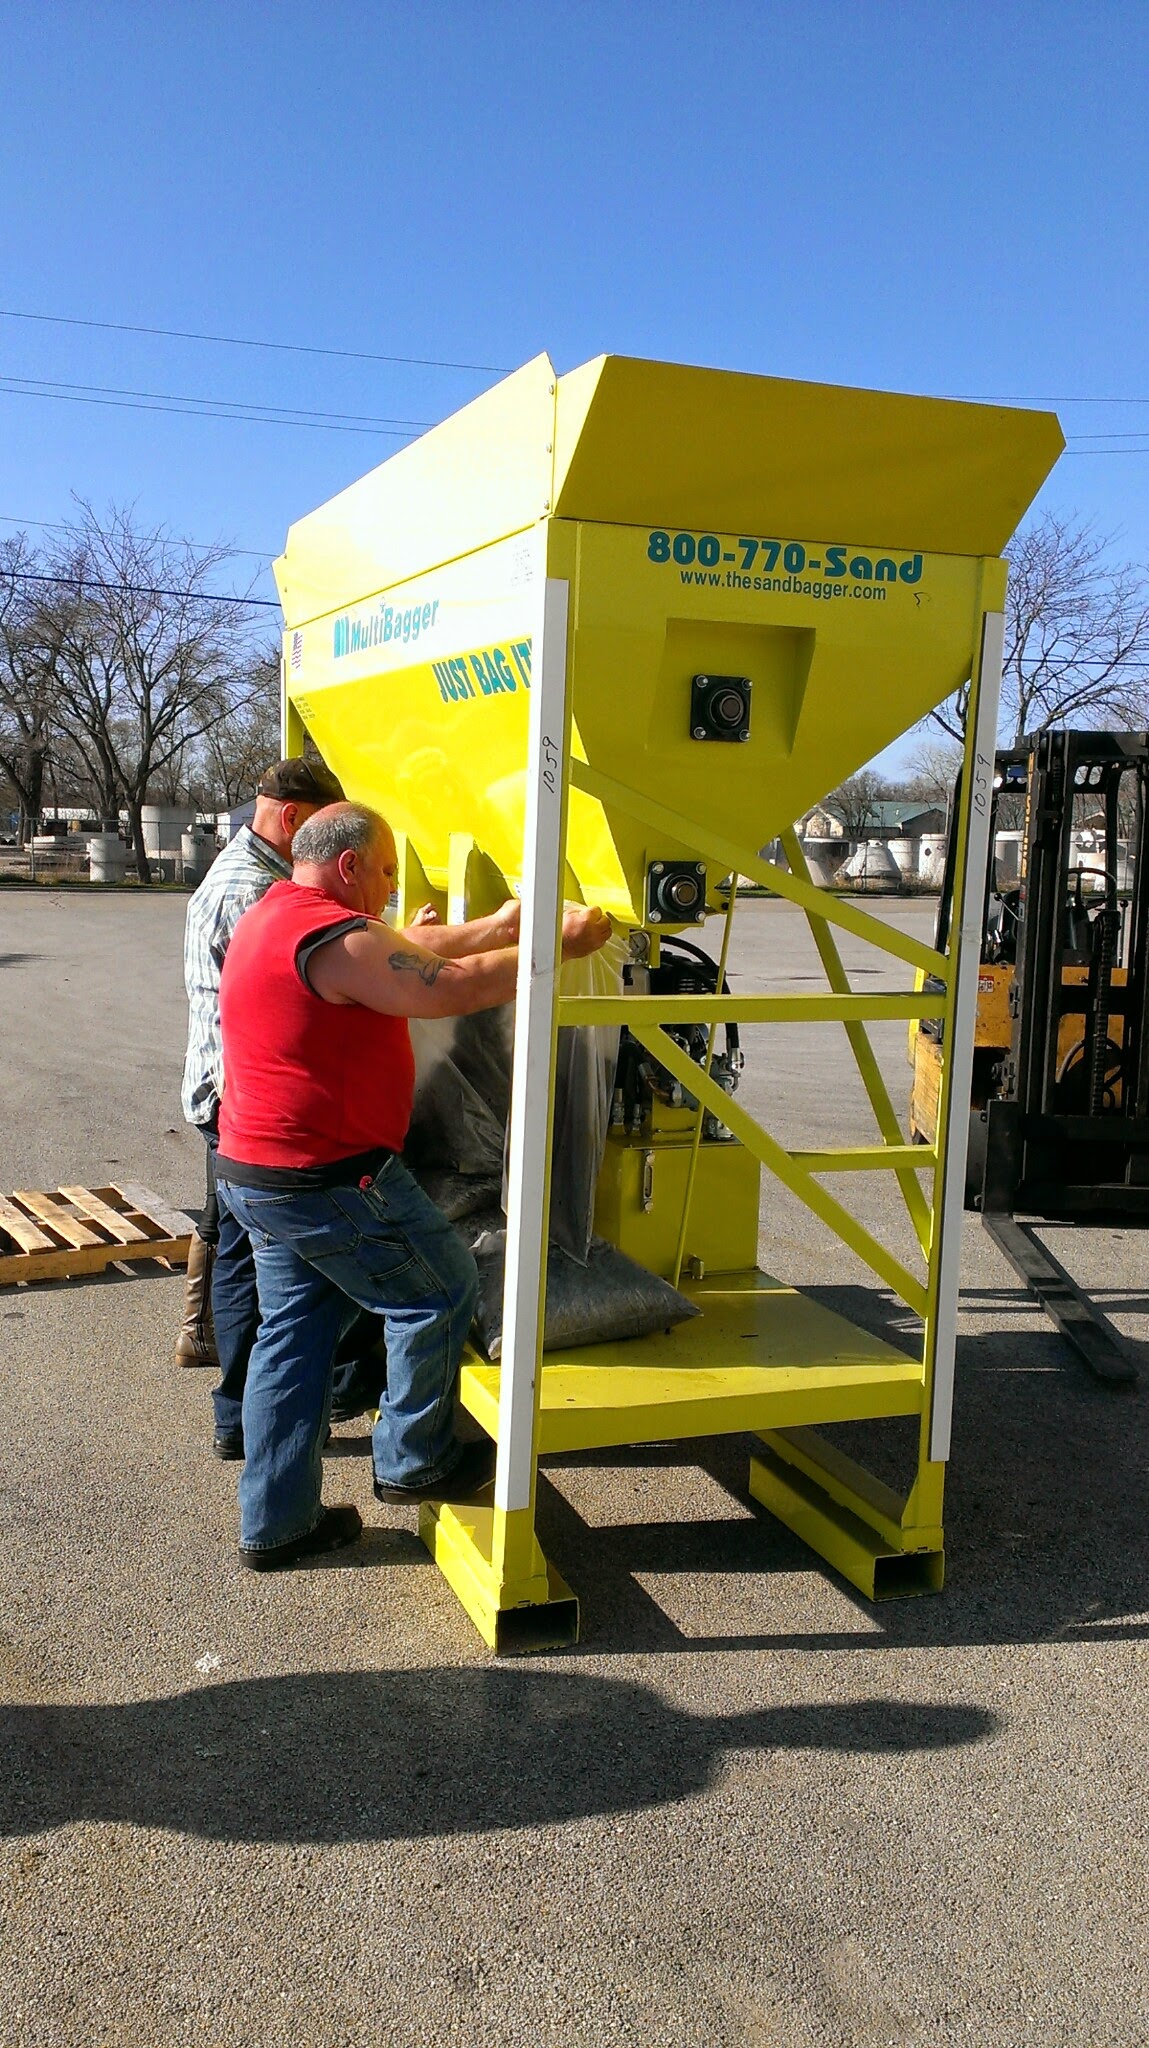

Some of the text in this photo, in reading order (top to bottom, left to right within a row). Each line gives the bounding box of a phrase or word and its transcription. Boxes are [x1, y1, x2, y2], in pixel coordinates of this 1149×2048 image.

[648, 530, 923, 584] 800-770-Sand
[680, 569, 887, 601] www.thesandbagger.com
[350, 598, 440, 653] MultiBagger
[432, 657, 476, 703] JUST
[469, 648, 517, 696] BAG
[542, 735, 559, 794] 1059
[974, 753, 991, 817] 1059
